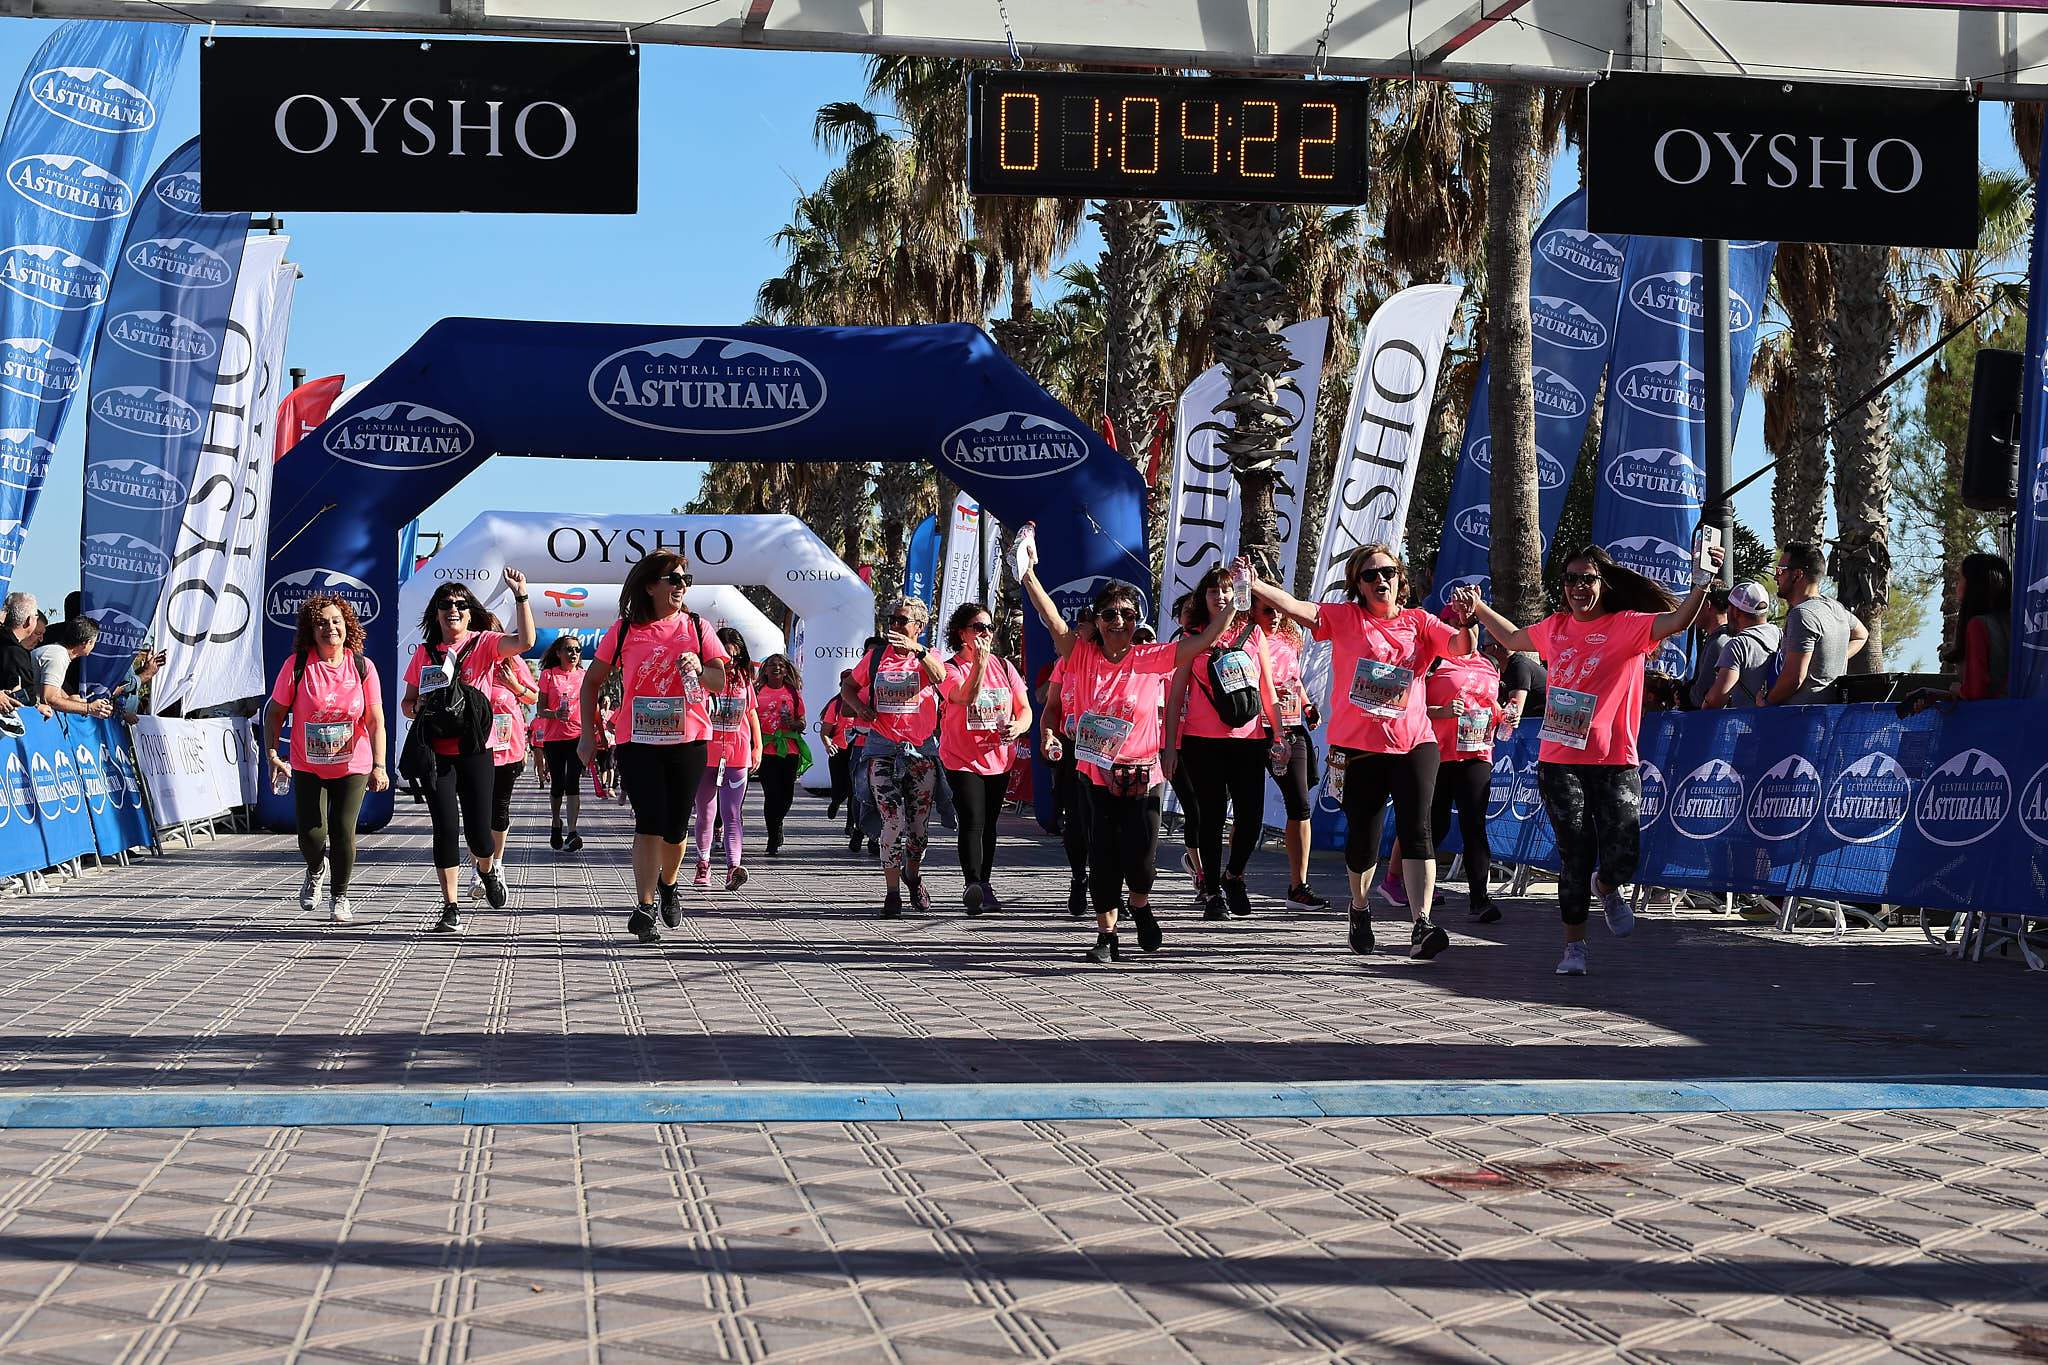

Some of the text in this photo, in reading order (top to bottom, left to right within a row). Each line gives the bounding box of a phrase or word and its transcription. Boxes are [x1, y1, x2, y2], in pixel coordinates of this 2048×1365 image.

[37, 77, 145, 126] ASTURIANA
[61, 80, 100, 97] CENTRAL
[274, 93, 577, 160] OYSHO
[39, 167, 79, 184] CENTRAL
[1653, 128, 1923, 193] OYSHO
[15, 164, 124, 212] ASTURIANA
[132, 247, 223, 283] ASTURIANA
[1543, 235, 1619, 278] ASTURIANA
[0, 255, 102, 299] ASTURIANA
[1660, 285, 1699, 299] CENTRAL
[113, 319, 208, 356] ASTURIANA
[1531, 312, 1599, 345] STURIANA
[644, 364, 802, 378] CENTRAL LECHERA
[1643, 375, 1682, 388] CENTRAL
[607, 364, 810, 410] ASTURIANA
[97, 395, 192, 431] ASTURIANA
[331, 426, 463, 454] ASTURIANA
[357, 423, 460, 435] CENTRAL LECHERA
[973, 432, 1073, 445] CENTRAL LECHERA
[953, 439, 1080, 464] ASTURIANA
[166, 318, 252, 646] OYSHO
[1629, 463, 1668, 475] CENTRAL
[86, 470, 178, 503] ASTURIANA
[547, 527, 734, 566] OYSHO
[1617, 552, 1692, 569] CENTRAL LECHER
[433, 568, 490, 581] OYSHO
[786, 569, 841, 582] OYSHO
[283, 588, 370, 599] CENTRAL LECHERA
[543, 611, 589, 619] TotalEnergies
[1828, 785, 1903, 819] ASTURIANA
[1940, 782, 2003, 792] CENTRAL LECHERA
[1673, 788, 1739, 818] ASTURIANA
[1750, 787, 1814, 818] ASTURIANA
[1919, 785, 2001, 821] ASTURIANA
